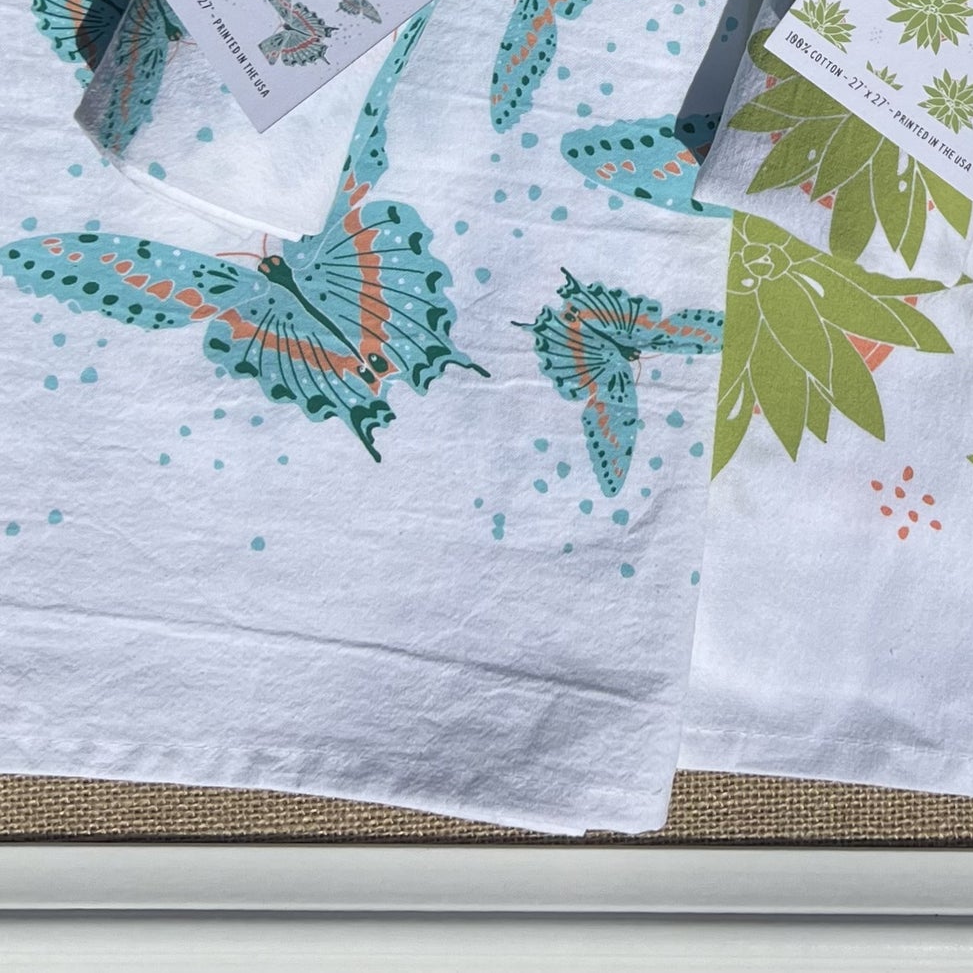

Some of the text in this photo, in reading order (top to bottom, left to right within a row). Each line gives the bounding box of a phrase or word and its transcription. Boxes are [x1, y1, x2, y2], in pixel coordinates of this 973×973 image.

[213, 18, 241, 54] PRINTED
[236, 53, 248, 64] IN
[243, 62, 259, 81] THE
[254, 79, 270, 98] USA
[785, 30, 812, 54] 100%
[809, 50, 844, 77] COTTON
[893, 110, 929, 140] PRINTED
[927, 135, 940, 148] IN
[938, 143, 956, 160] THE
[954, 155, 972, 172] USA
